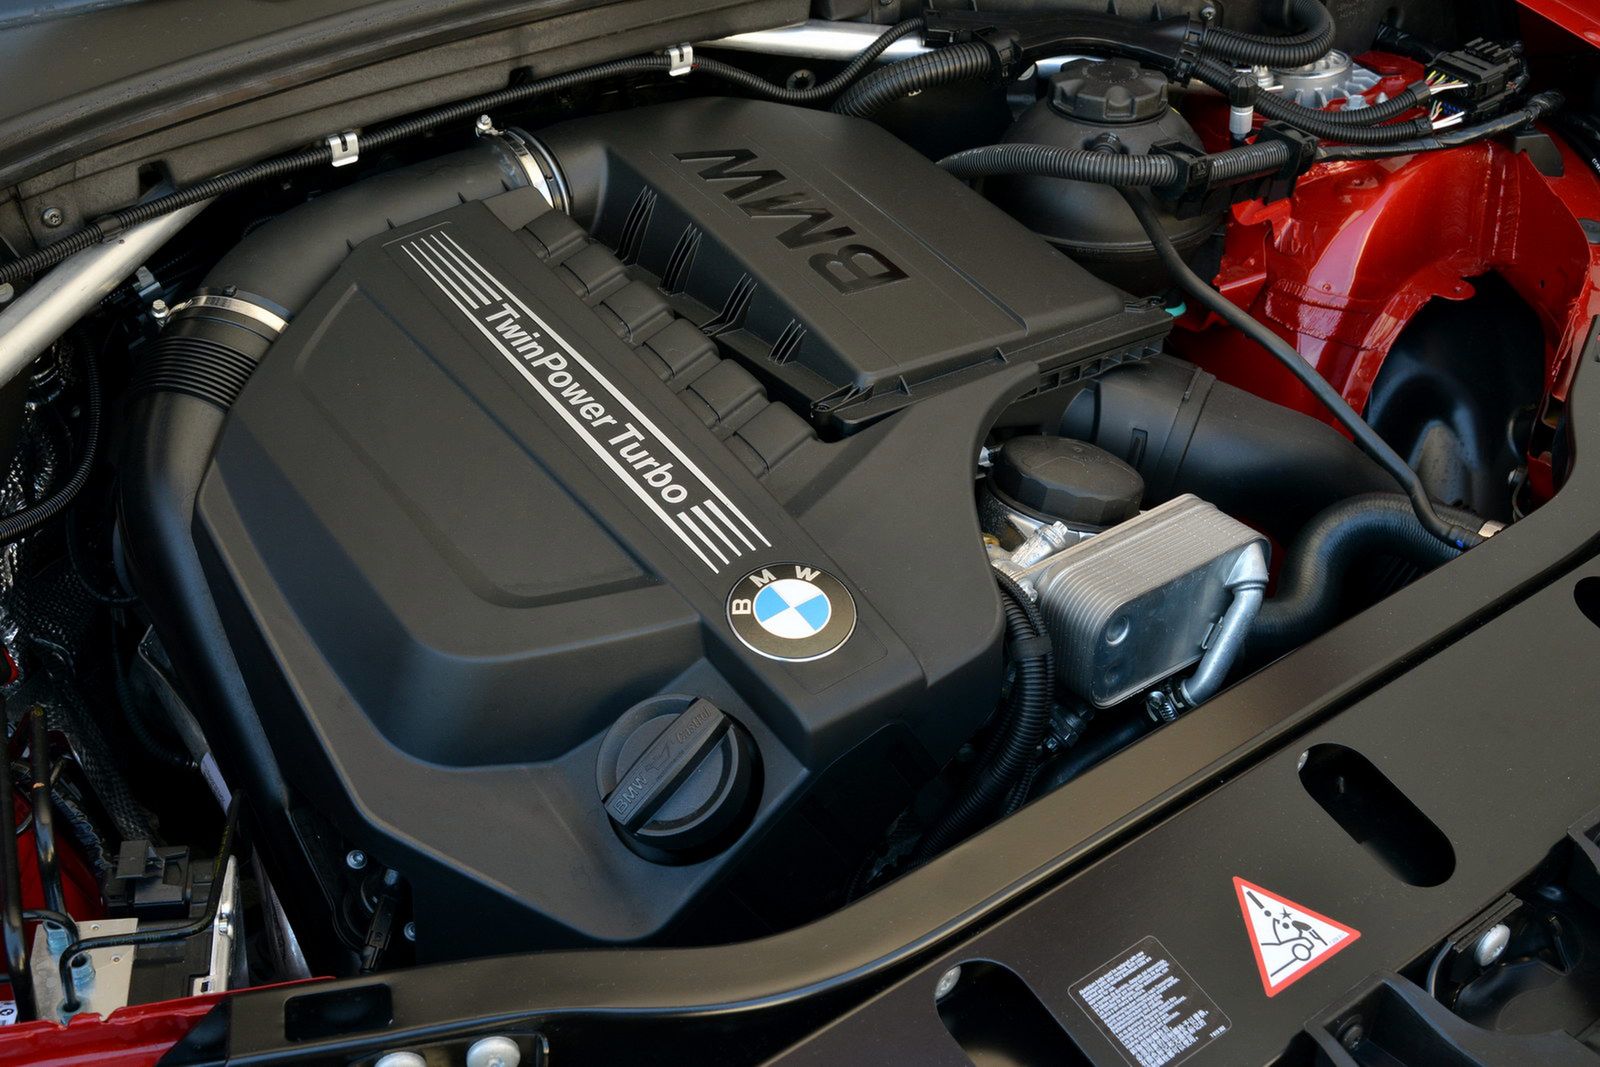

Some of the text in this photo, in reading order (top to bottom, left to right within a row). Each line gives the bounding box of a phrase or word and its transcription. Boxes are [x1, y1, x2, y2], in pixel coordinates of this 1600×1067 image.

[672, 149, 910, 295] BMW
[486, 303, 688, 503] TwinPower Turbo
[731, 565, 821, 615] BMW
[614, 772, 648, 815] BMW
